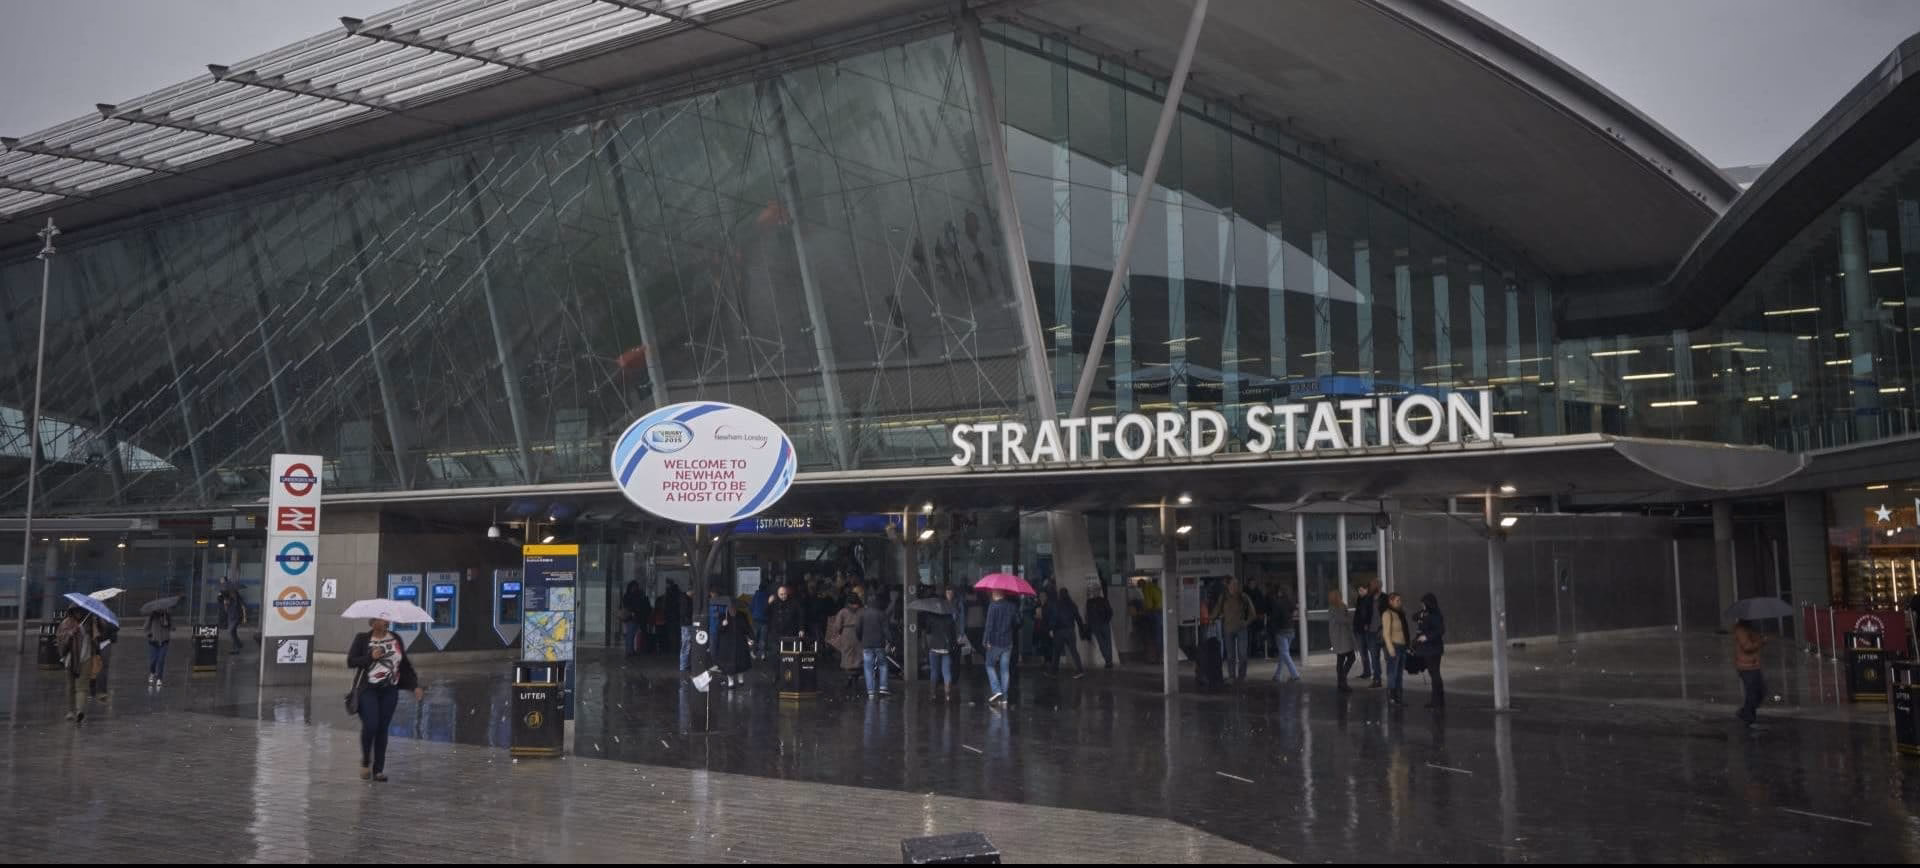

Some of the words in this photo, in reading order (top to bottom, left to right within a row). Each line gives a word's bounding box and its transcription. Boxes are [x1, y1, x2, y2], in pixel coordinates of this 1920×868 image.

[951, 410, 1228, 466] STRATFORD
[1246, 390, 1494, 454] STATION
[714, 432, 742, 441] Newham
[744, 433, 768, 442] London
[664, 459, 727, 469] WELCOME
[731, 459, 747, 469] TO
[675, 470, 735, 480] NEWHAM
[662, 481, 707, 491] PROUD
[711, 481, 727, 491] TO
[730, 481, 746, 491] BE
[666, 492, 674, 502] A
[678, 492, 712, 502] HOST
[715, 492, 743, 502] CITY
[760, 518, 805, 529] STRATFORD
[520, 692, 546, 700] LITTER
